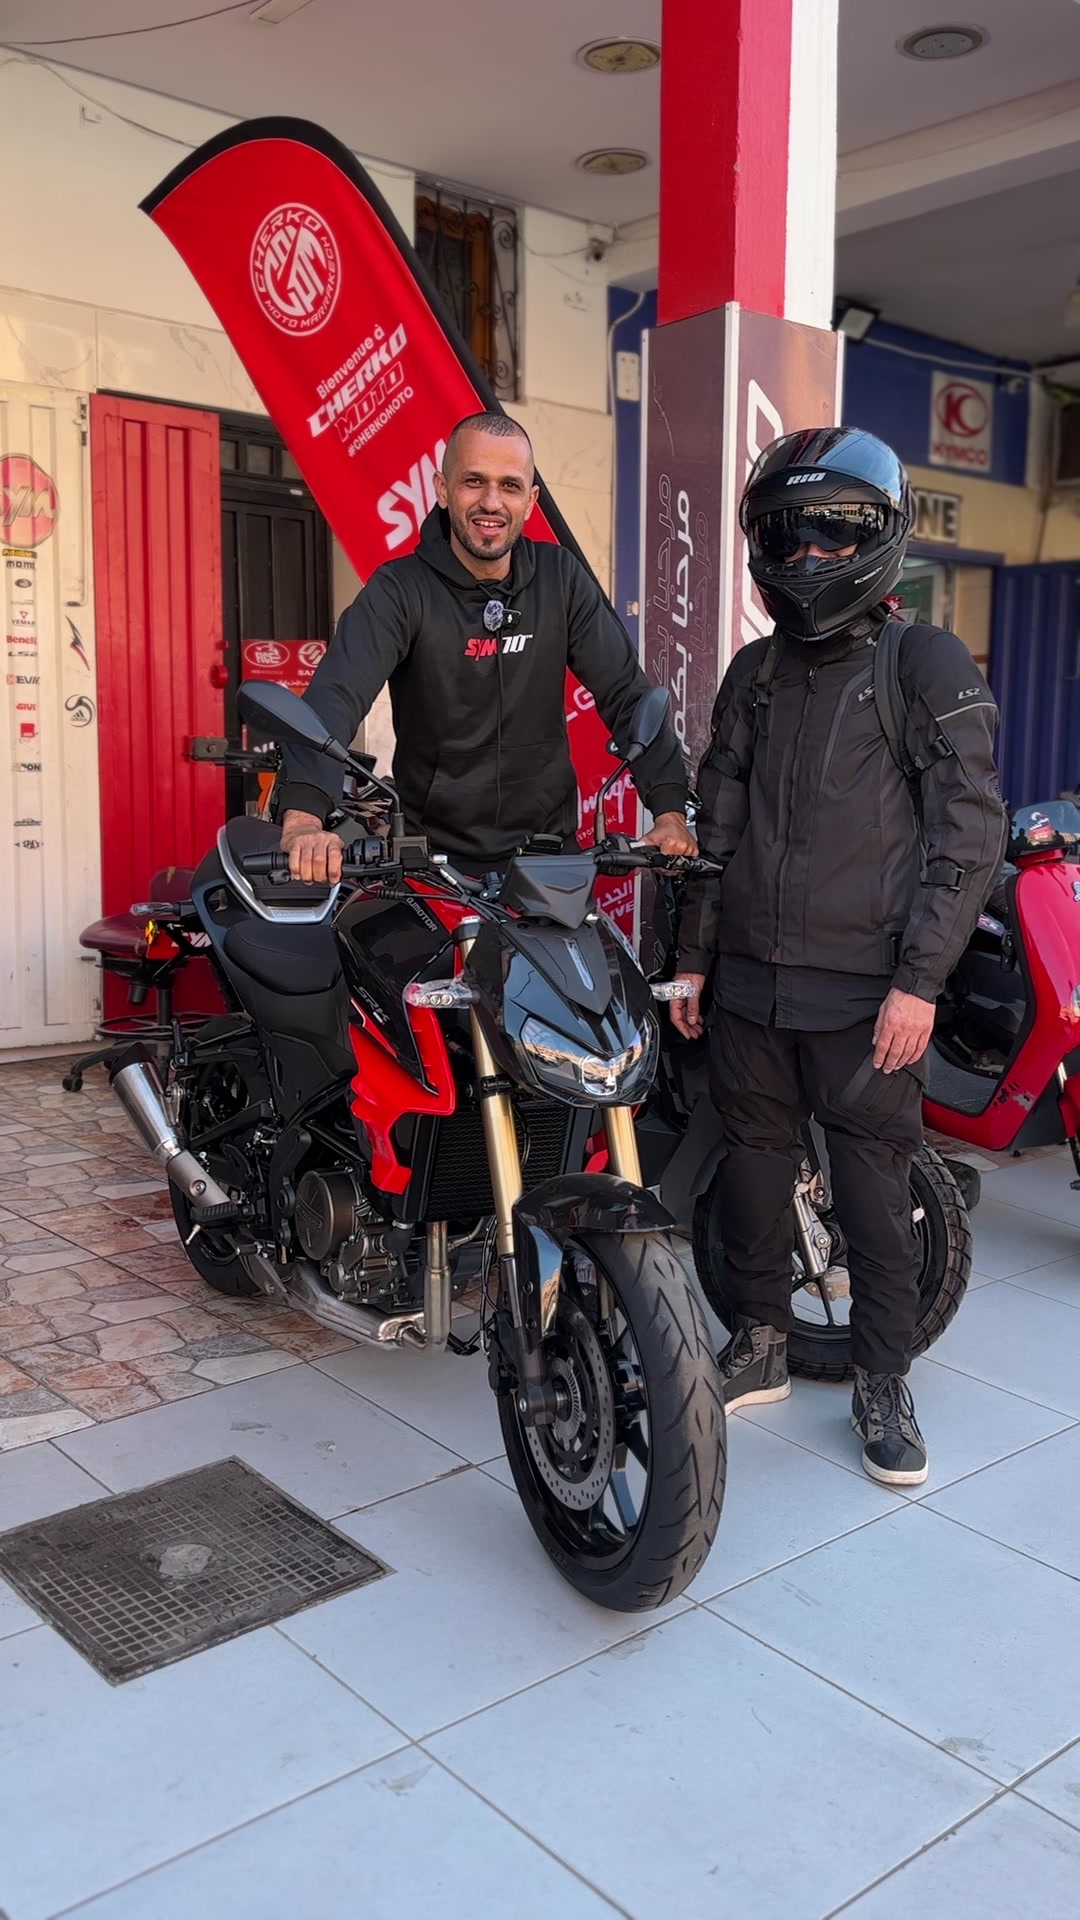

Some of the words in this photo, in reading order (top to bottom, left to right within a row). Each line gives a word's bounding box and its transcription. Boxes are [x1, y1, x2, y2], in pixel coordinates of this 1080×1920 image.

[254, 210, 322, 292] CHERKO
[265, 300, 298, 328] MOTO
[300, 236, 336, 328] MARRAKECH
[306, 322, 407, 438] CHERKO
[316, 337, 374, 400] Bienvenue
[373, 323, 386, 341] à
[334, 361, 405, 443] MOTO
[347, 386, 413, 457] #CHERKOMOTO
[786, 472, 827, 486] RIO
[933, 445, 988, 466] KYMCO
[0, 485, 55, 526] YM
[671, 490, 694, 628] مرحبا
[464, 638, 498, 661] SYM
[957, 687, 980, 700] LS2
[353, 985, 391, 1022] SRK
